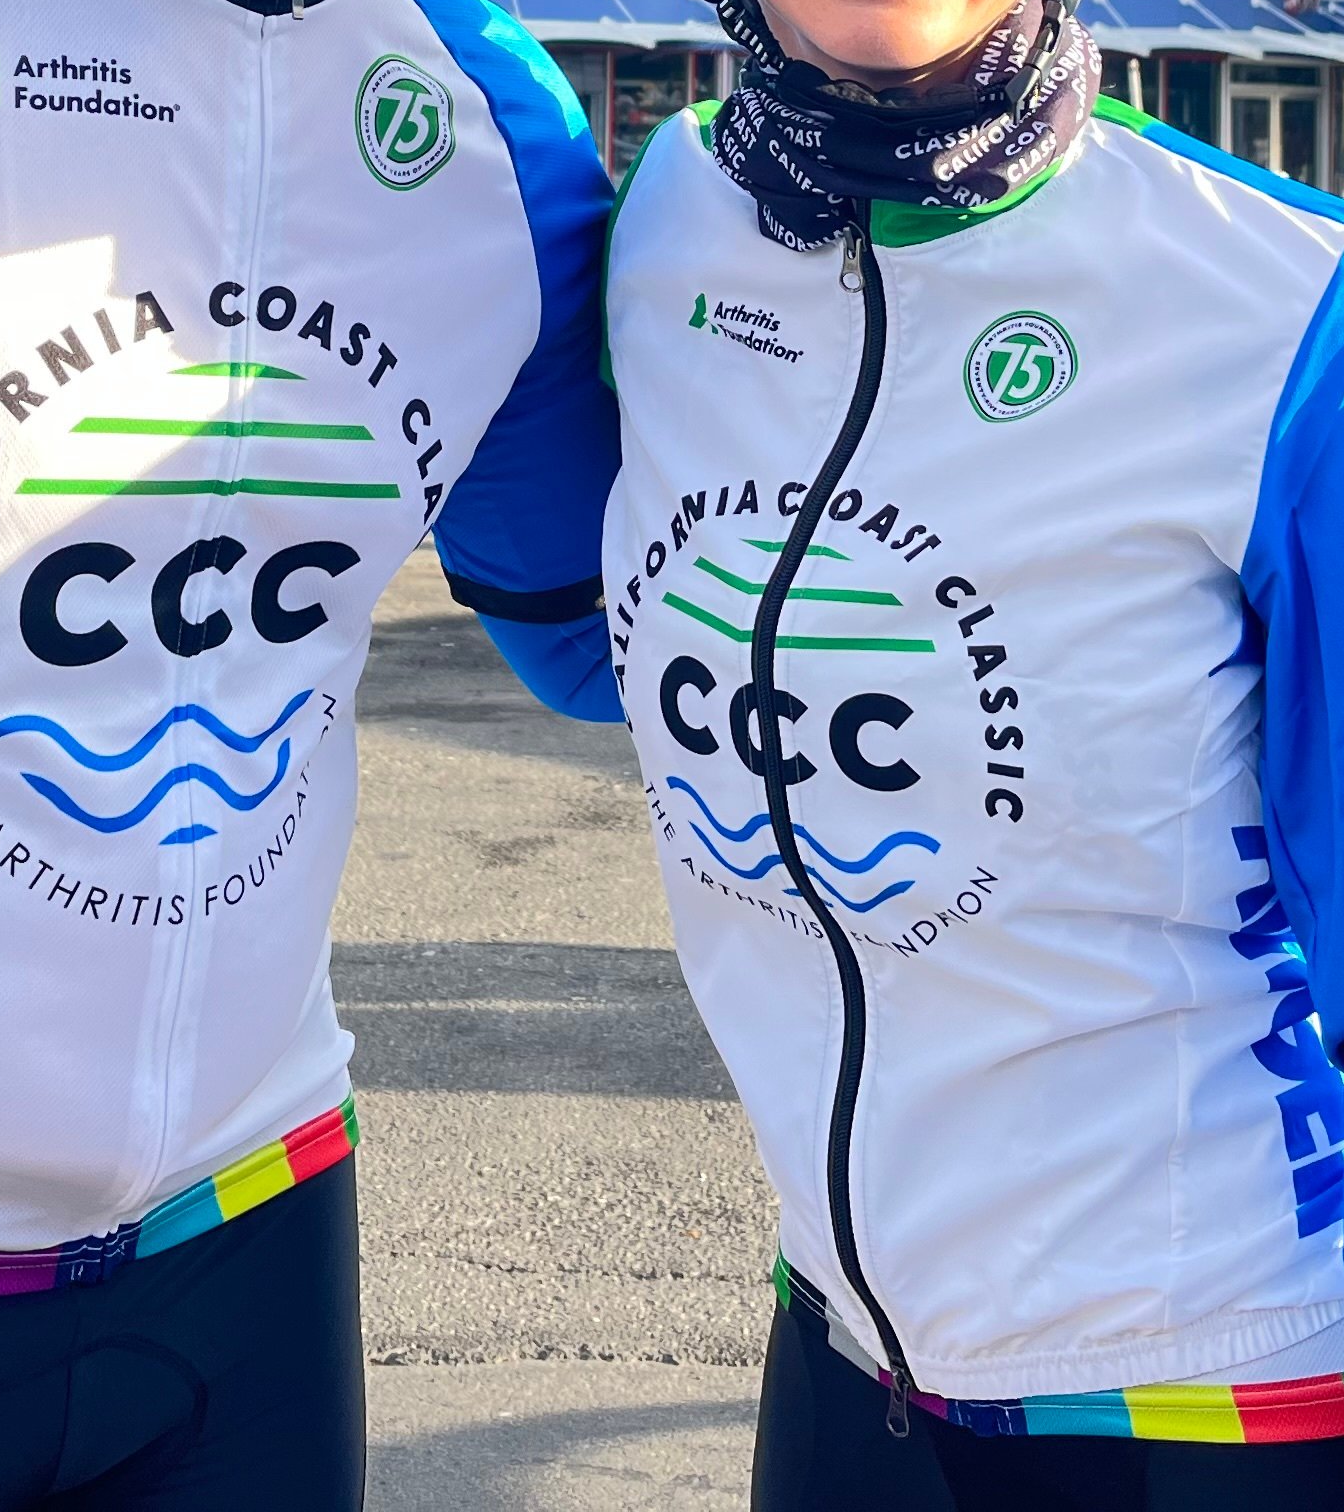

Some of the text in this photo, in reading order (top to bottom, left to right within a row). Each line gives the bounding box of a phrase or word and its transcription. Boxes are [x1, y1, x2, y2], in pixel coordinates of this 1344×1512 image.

[13, 55, 132, 85] Arthritis
[14, 86, 175, 123] Foundation
[377, 86, 440, 160] 75
[207, 281, 398, 399] COAST
[713, 300, 781, 332] Arthritis
[987, 341, 1058, 404] 75
[18, 534, 362, 667] CCC
[658, 653, 923, 793] CCC
[934, 574, 1026, 825] CLASSIC
[644, 780, 676, 843] THE
[680, 856, 825, 940] ARTHRITIS
